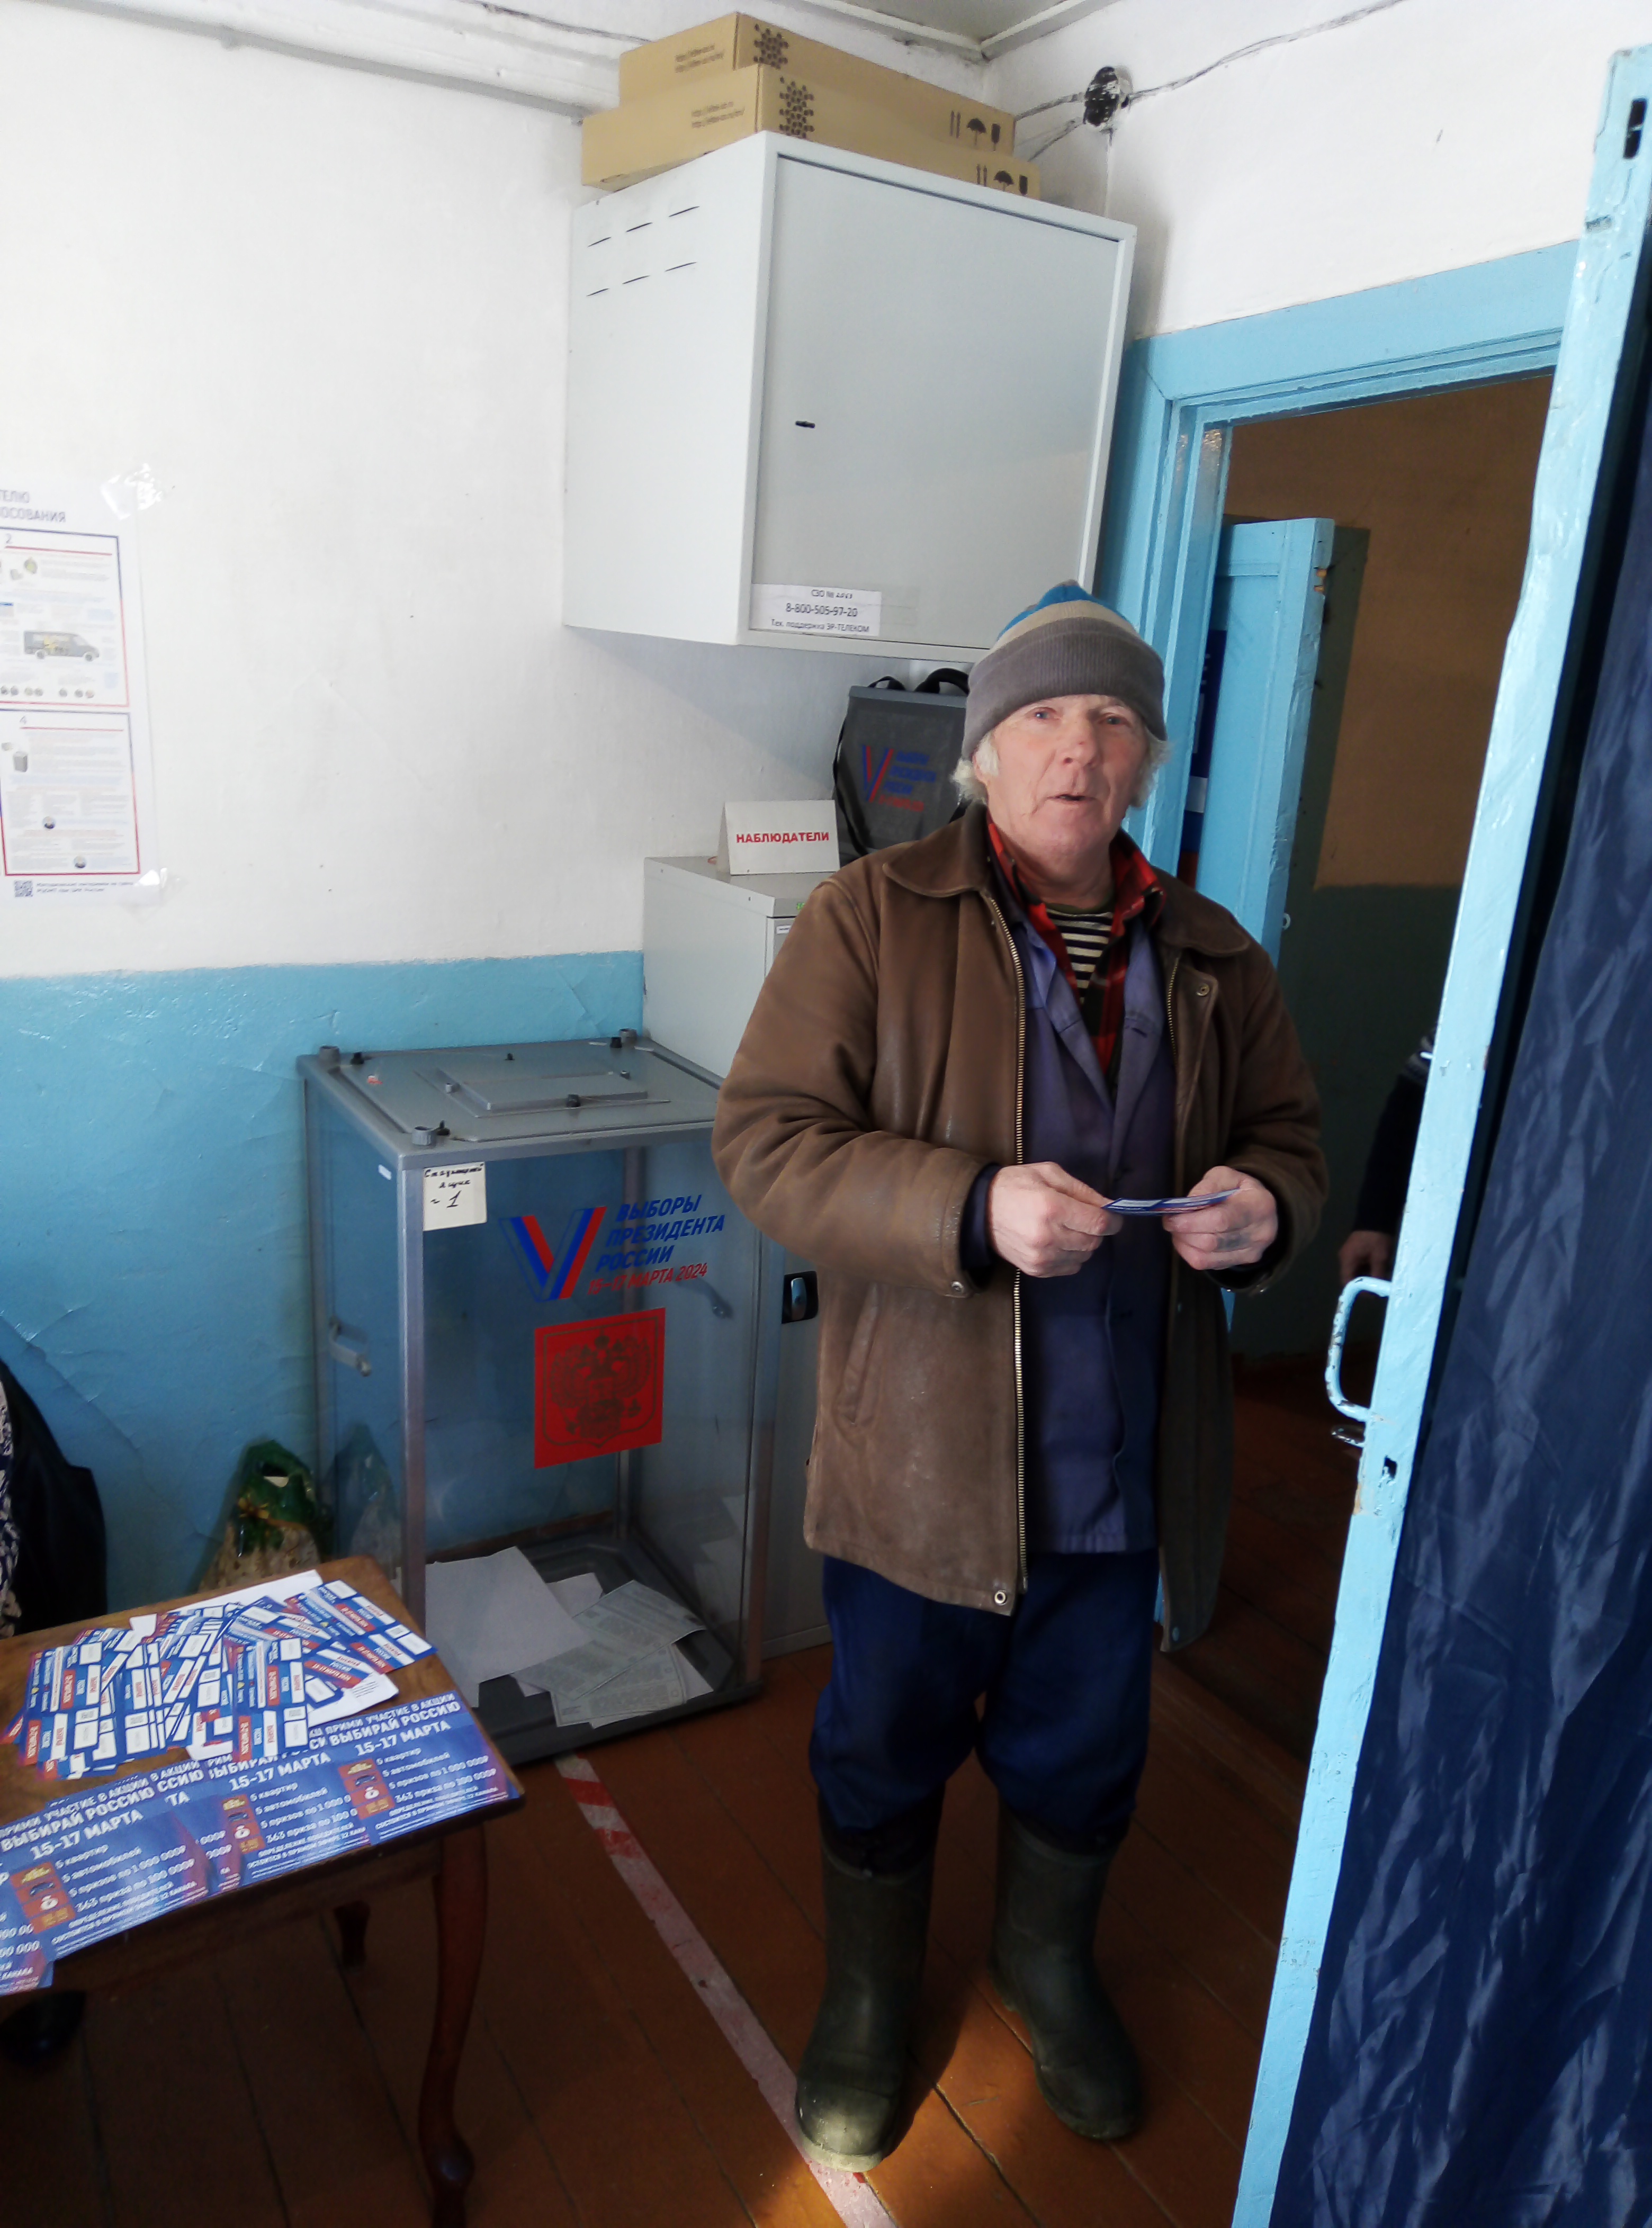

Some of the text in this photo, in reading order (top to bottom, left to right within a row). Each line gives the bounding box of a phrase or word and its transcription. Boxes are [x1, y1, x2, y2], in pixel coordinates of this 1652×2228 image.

[786, 603, 858, 617] 8-800-505-97-20
[736, 831, 830, 845] НАБЛЮДАТЕЛИ
[446, 1190, 462, 1208] 1
[615, 1194, 702, 1223] ВЫБОРЫ
[606, 1215, 725, 1248] ПРЕЗИДЕНТА
[596, 1245, 675, 1273] РОССИИ
[627, 1268, 674, 1289] МАРТА
[675, 1262, 708, 1282] 2024
[329, 1718, 400, 1746] ВЫБИРАЙ
[400, 1701, 461, 1726] РОССИЮ
[365, 1706, 410, 1724] УЧАСТИЕ
[354, 1720, 451, 1756] 15-17 МАРТА
[228, 1752, 331, 1791] 15-17 МАРТА
[97, 1792, 107, 1802] В
[1, 1811, 84, 1852] ВЫБИРАЙ
[85, 1786, 155, 1821] РОССИЮ
[30, 1809, 144, 1860] 15-17 МАРТА
[266, 1830, 285, 1844] 363
